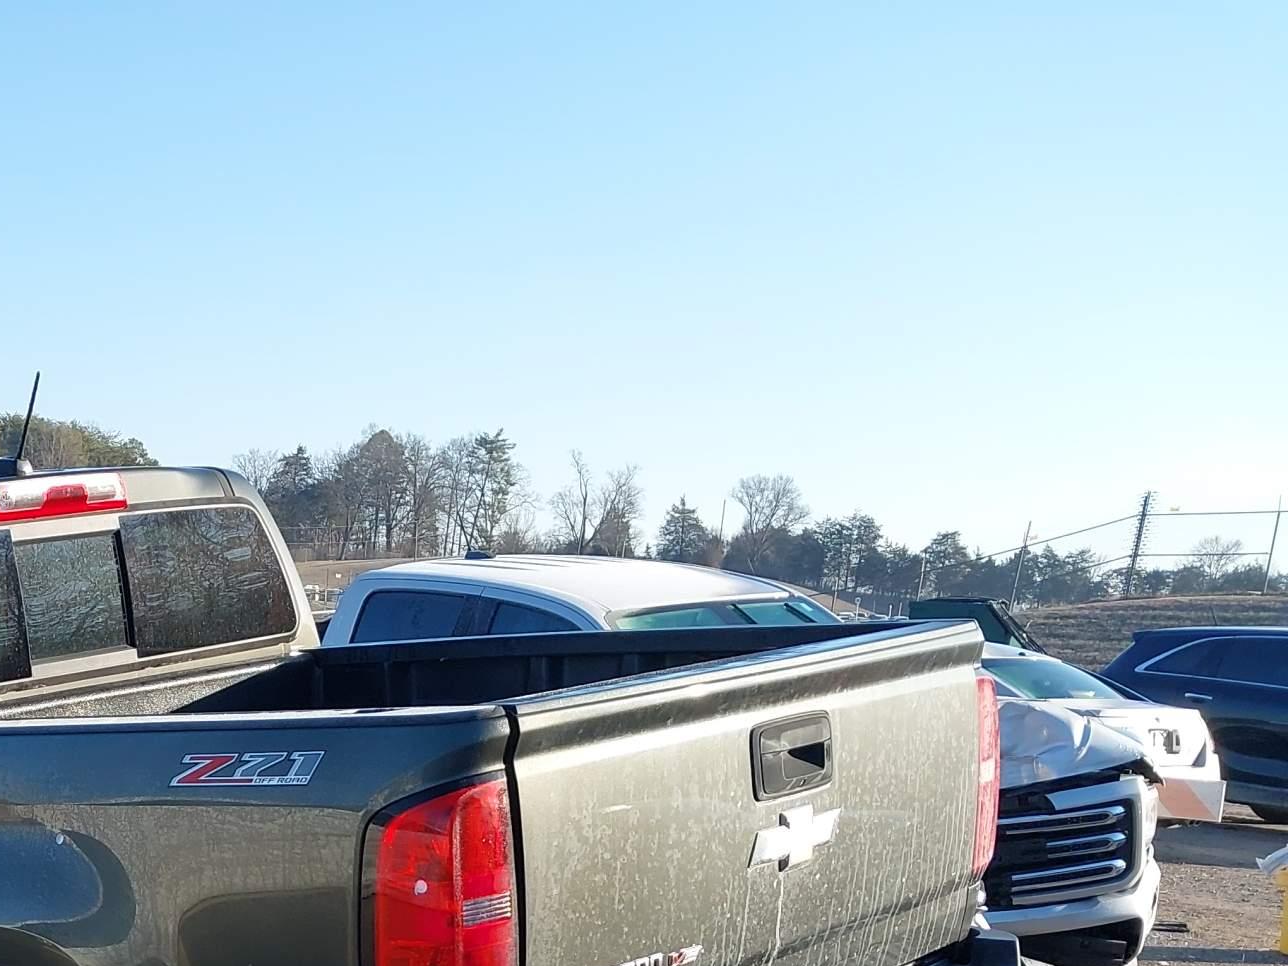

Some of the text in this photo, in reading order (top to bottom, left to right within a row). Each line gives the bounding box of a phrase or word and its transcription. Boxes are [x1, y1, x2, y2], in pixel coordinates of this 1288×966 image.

[169, 750, 326, 786] Z71
[254, 776, 308, 784] OFF ROAD
